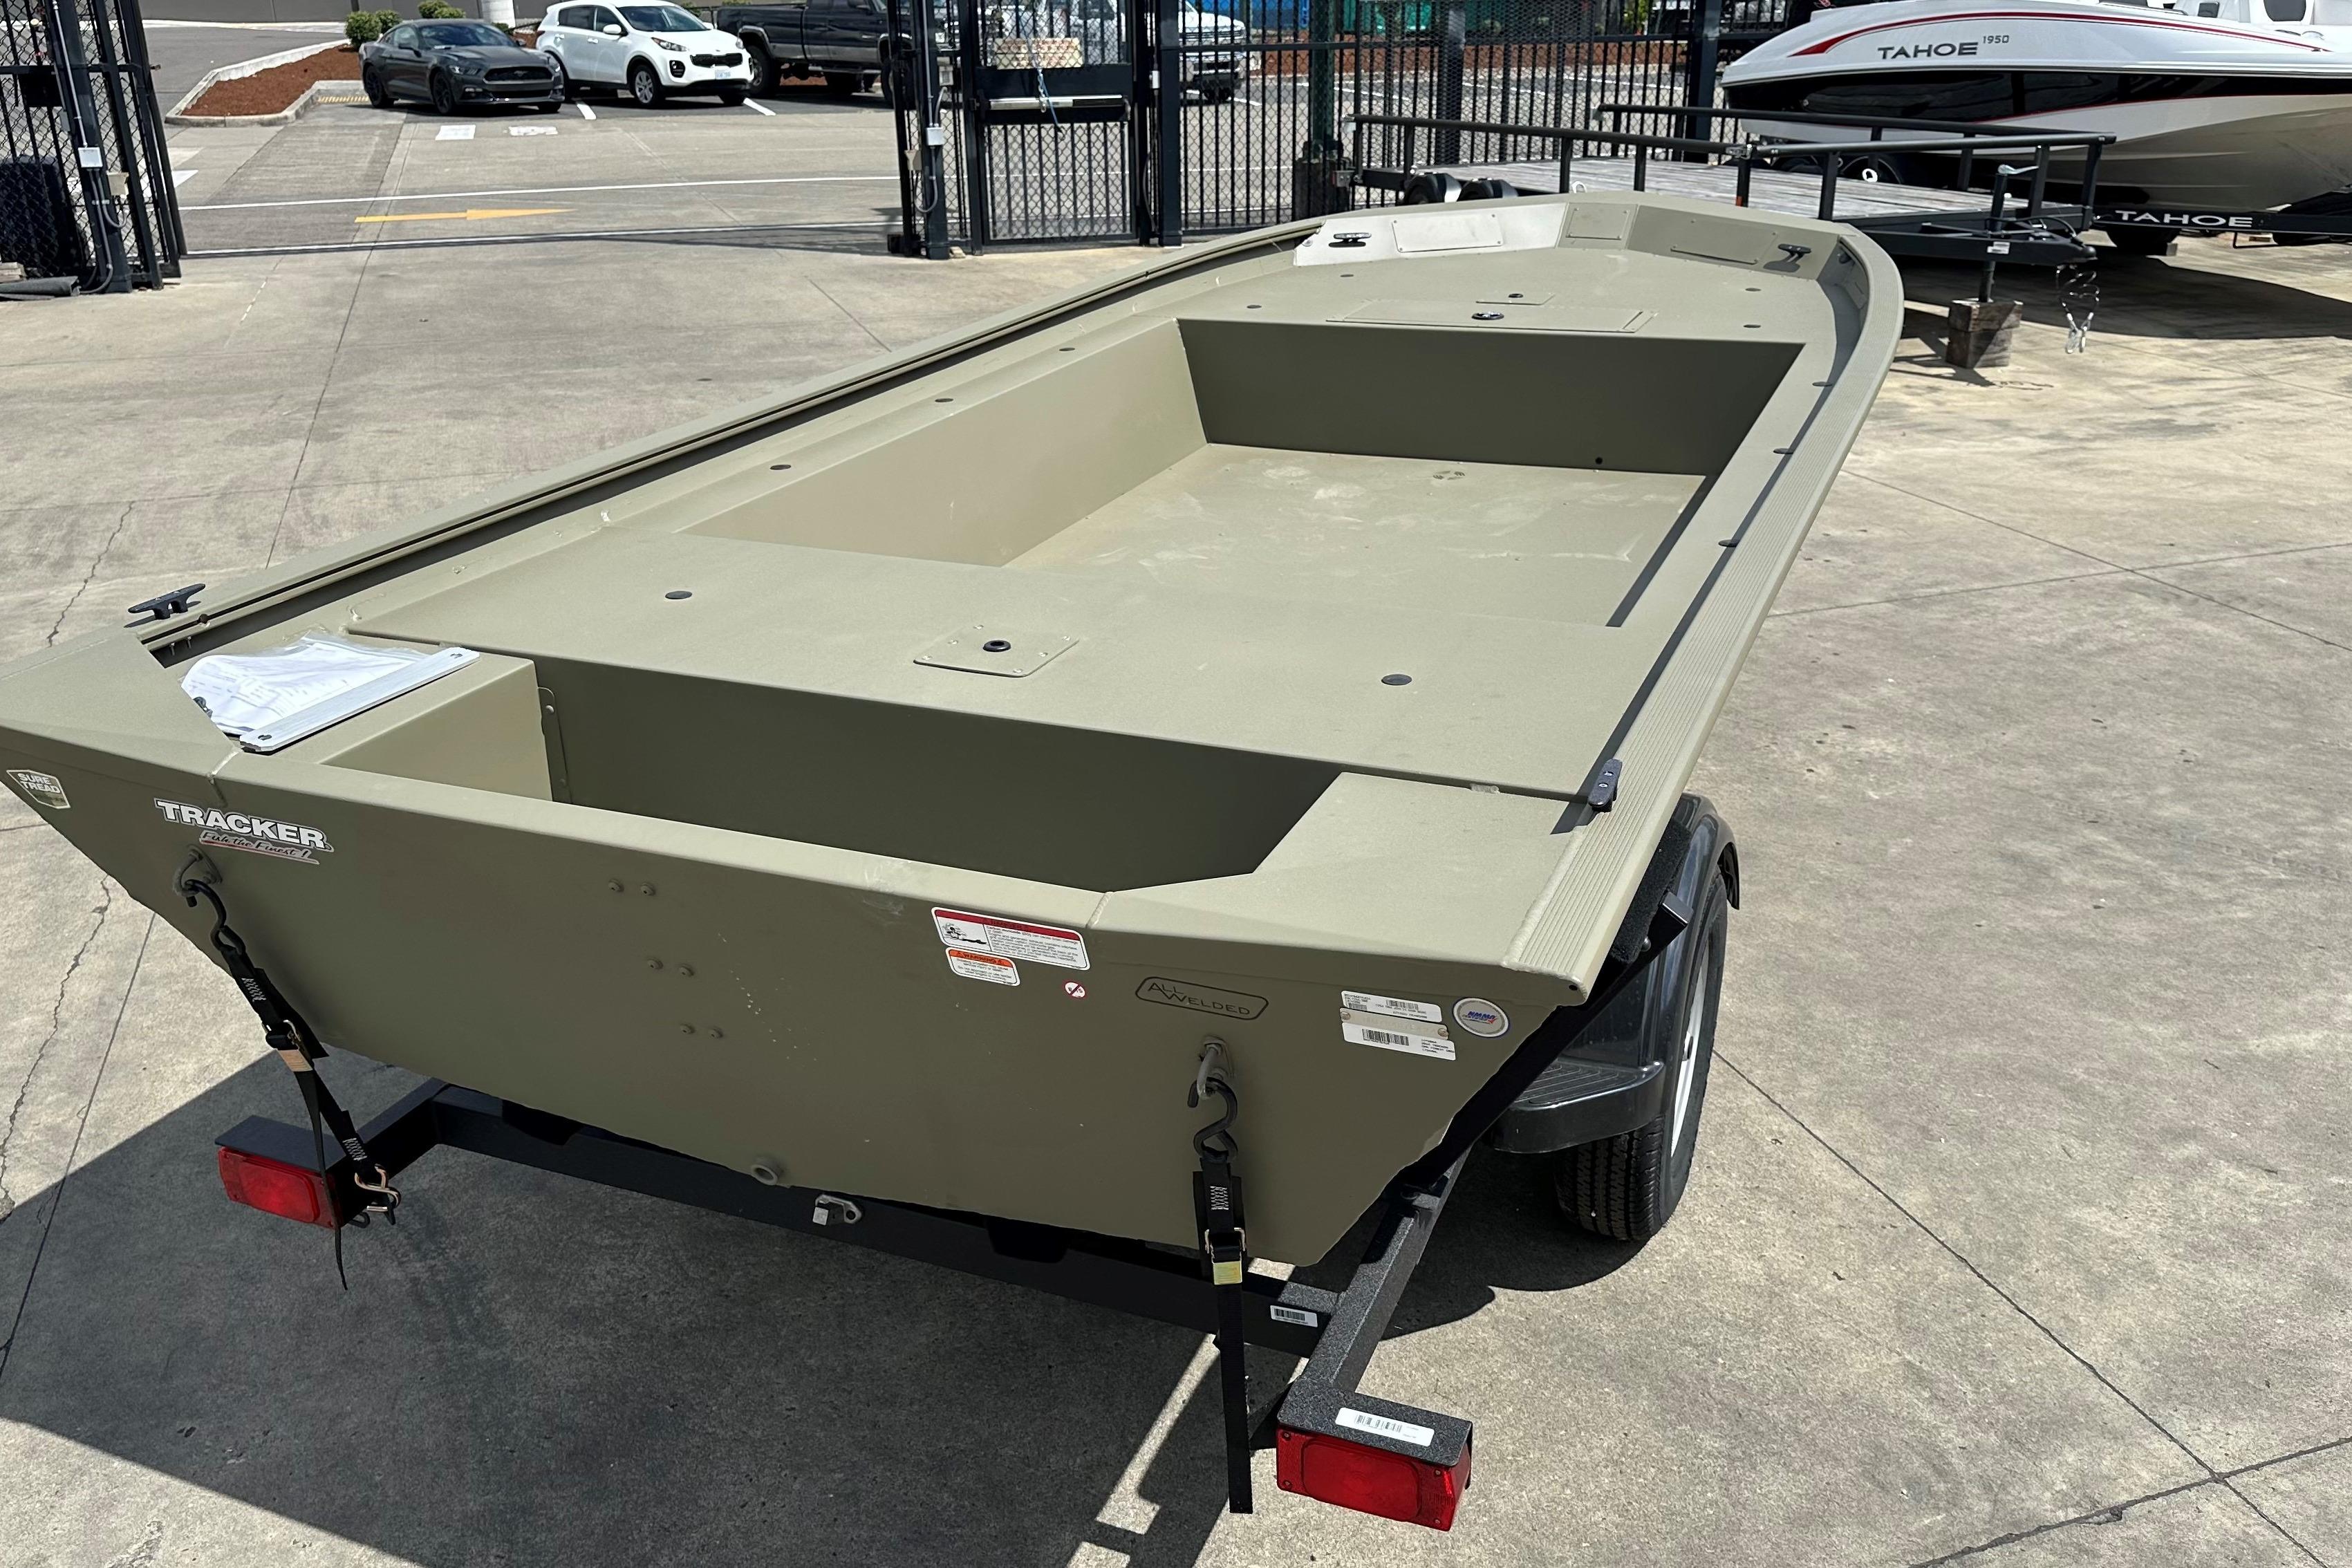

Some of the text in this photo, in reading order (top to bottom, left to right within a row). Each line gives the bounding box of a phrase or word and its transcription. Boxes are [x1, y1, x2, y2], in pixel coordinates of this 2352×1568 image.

[1878, 35, 2009, 59] TAHOE 1950
[2115, 210, 2253, 227] TAHOE
[17, 773, 52, 785] SURE
[20, 781, 61, 794] TREAD
[156, 800, 326, 850] TRACKER
[203, 831, 230, 843] Fish
[233, 837, 252, 847] the
[1148, 982, 1184, 994] ALL
[1158, 993, 1250, 1015] WELDED
